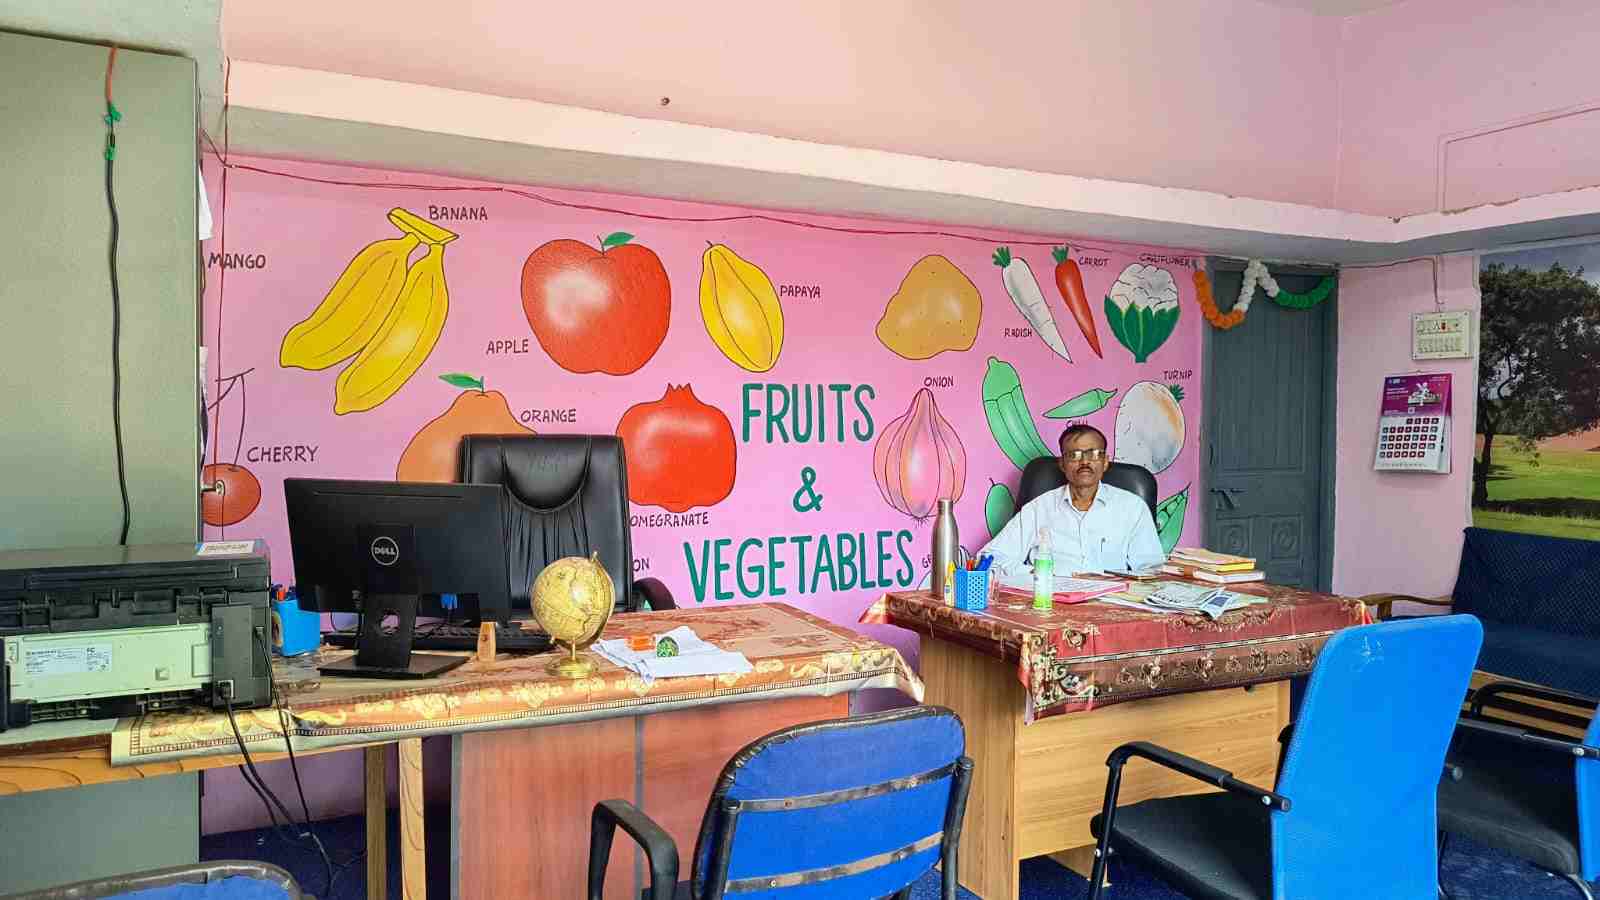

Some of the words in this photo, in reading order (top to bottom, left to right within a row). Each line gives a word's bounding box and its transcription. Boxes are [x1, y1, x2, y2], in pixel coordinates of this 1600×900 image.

[428, 205, 488, 221] BANANA
[208, 252, 266, 269] MANGO
[1078, 256, 1109, 266] CARROT
[780, 285, 821, 299] PAPAYA
[1004, 327, 1033, 338] RADISH
[486, 339, 529, 355] APPLE
[923, 376, 954, 388] ONION
[1163, 369, 1193, 381] TURNIP
[520, 408, 577, 423] ORANGE
[742, 383, 876, 443] FRUITS
[246, 445, 319, 463] CHERRY
[792, 466, 824, 513] &
[629, 511, 710, 528] OMEGRANATE
[374, 546, 396, 556] DELL
[683, 530, 914, 603] VEGETABLES
